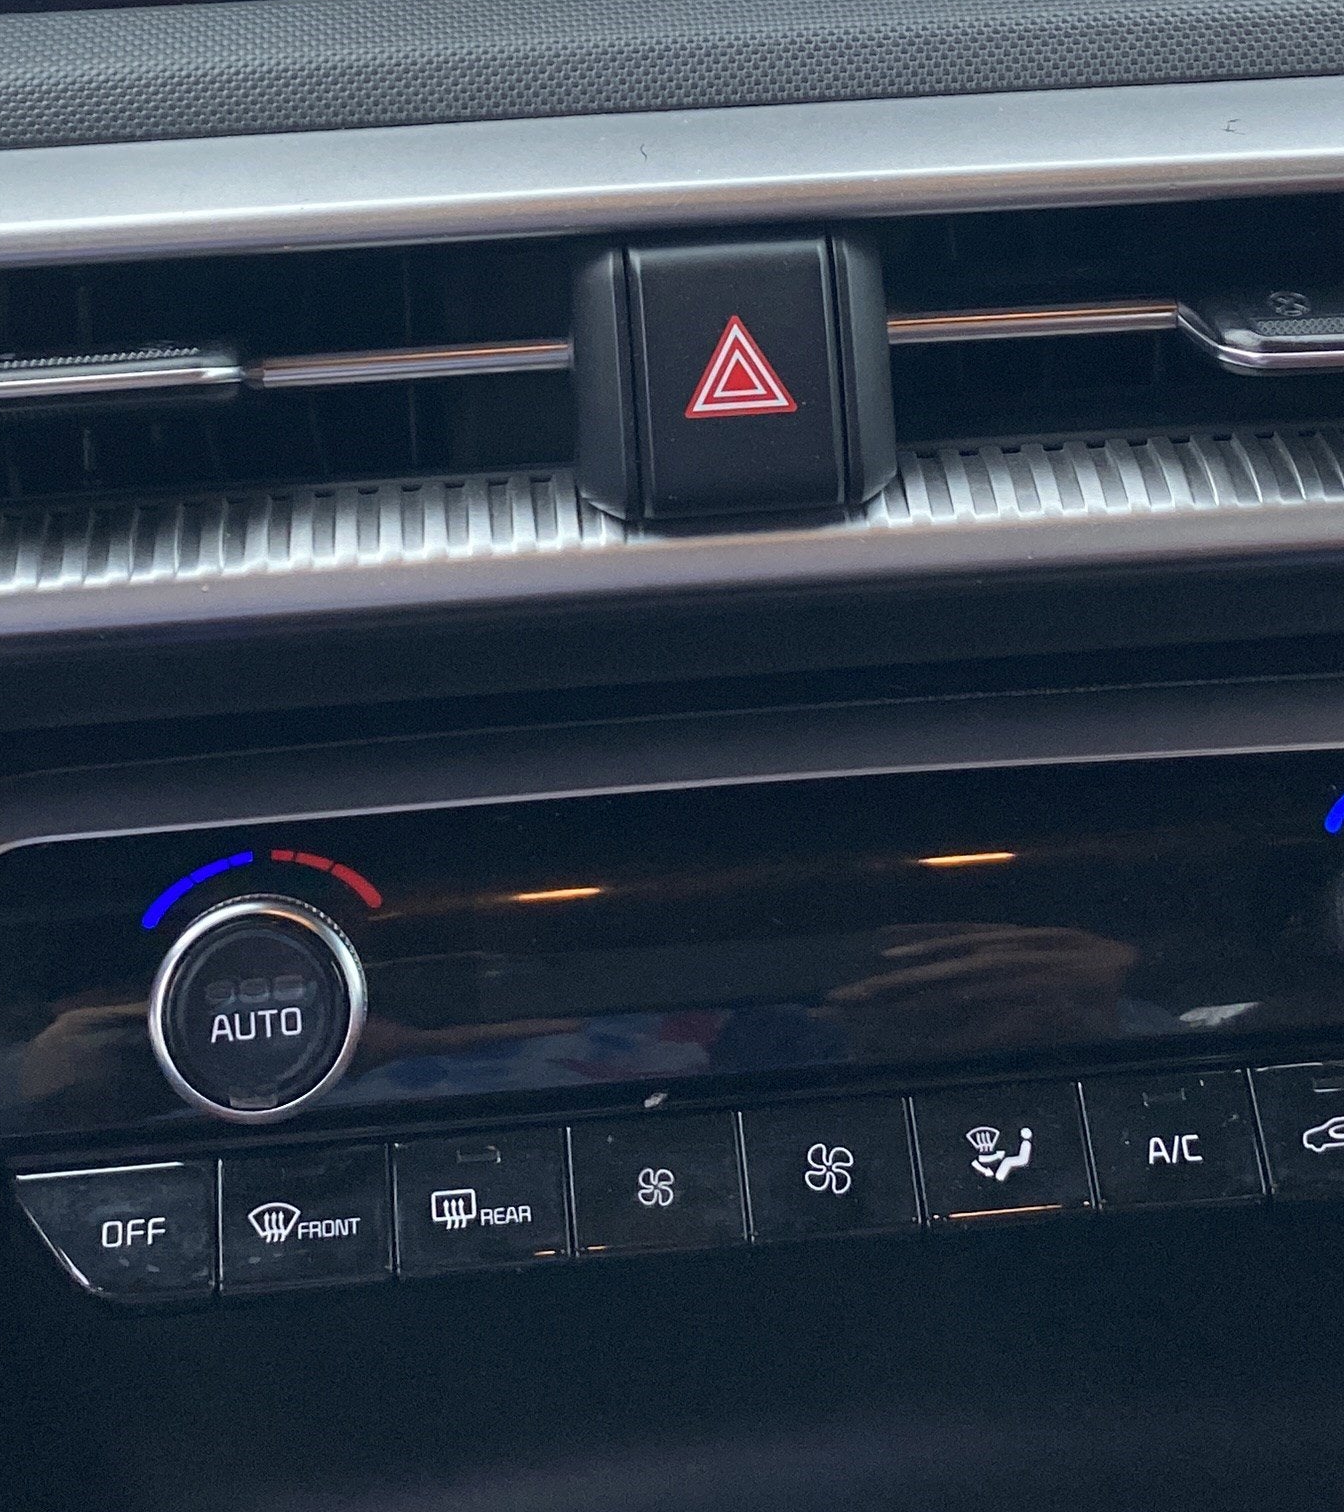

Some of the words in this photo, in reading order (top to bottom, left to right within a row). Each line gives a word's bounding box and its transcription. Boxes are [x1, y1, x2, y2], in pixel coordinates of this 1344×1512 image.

[210, 1007, 303, 1044] AUTO
[1148, 1134, 1203, 1165] A/C
[296, 1217, 361, 1241] FRONT
[480, 1204, 533, 1227] REAR
[100, 1217, 166, 1249] OFF
